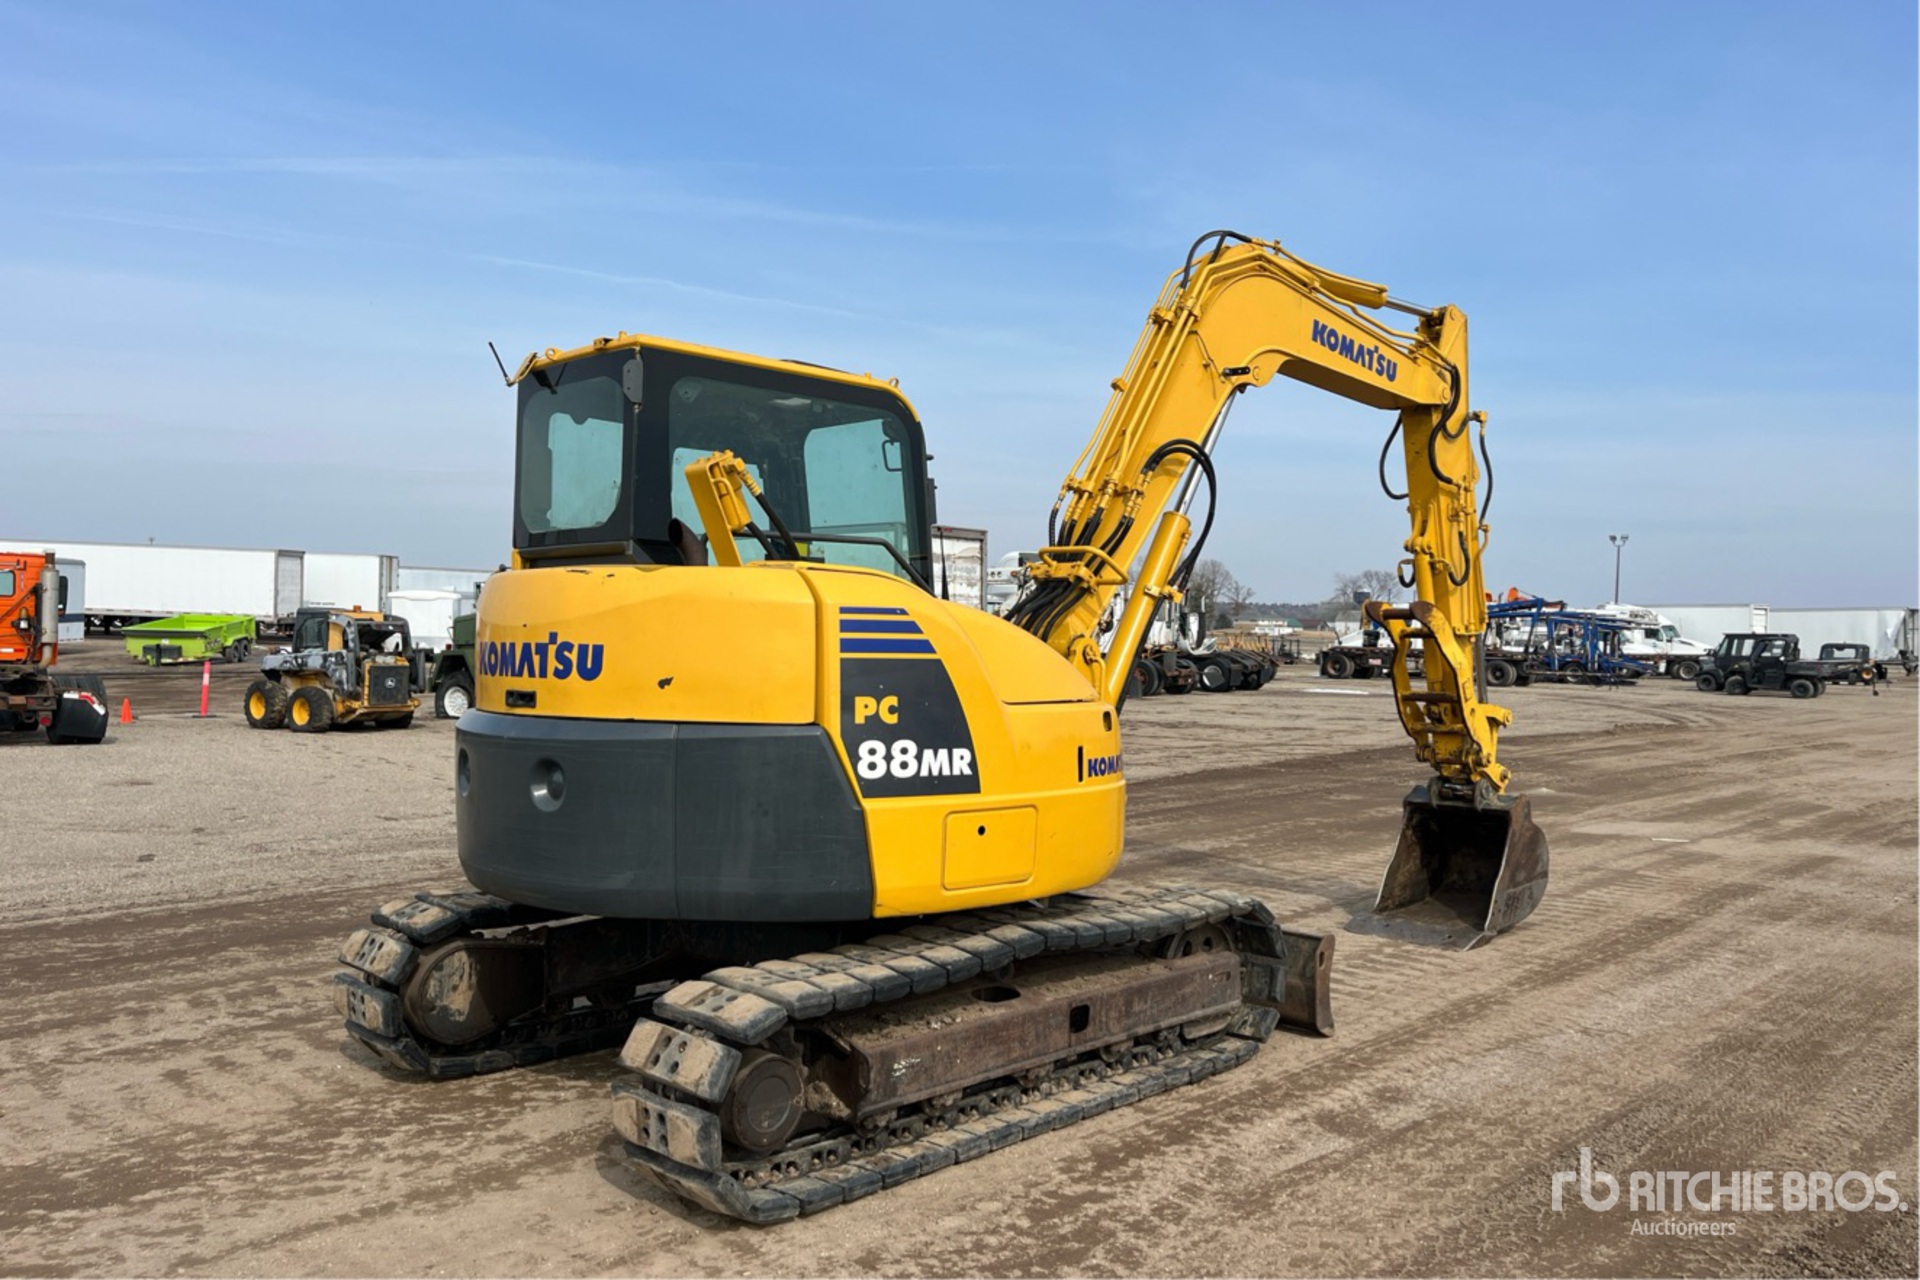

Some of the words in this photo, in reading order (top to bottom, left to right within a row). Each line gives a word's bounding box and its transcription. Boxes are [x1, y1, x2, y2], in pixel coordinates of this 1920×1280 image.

[1312, 318, 1398, 382] KOMATSU
[480, 632, 604, 681] KOMATSU
[854, 695, 899, 724] PC
[857, 739, 973, 779] 88MR
